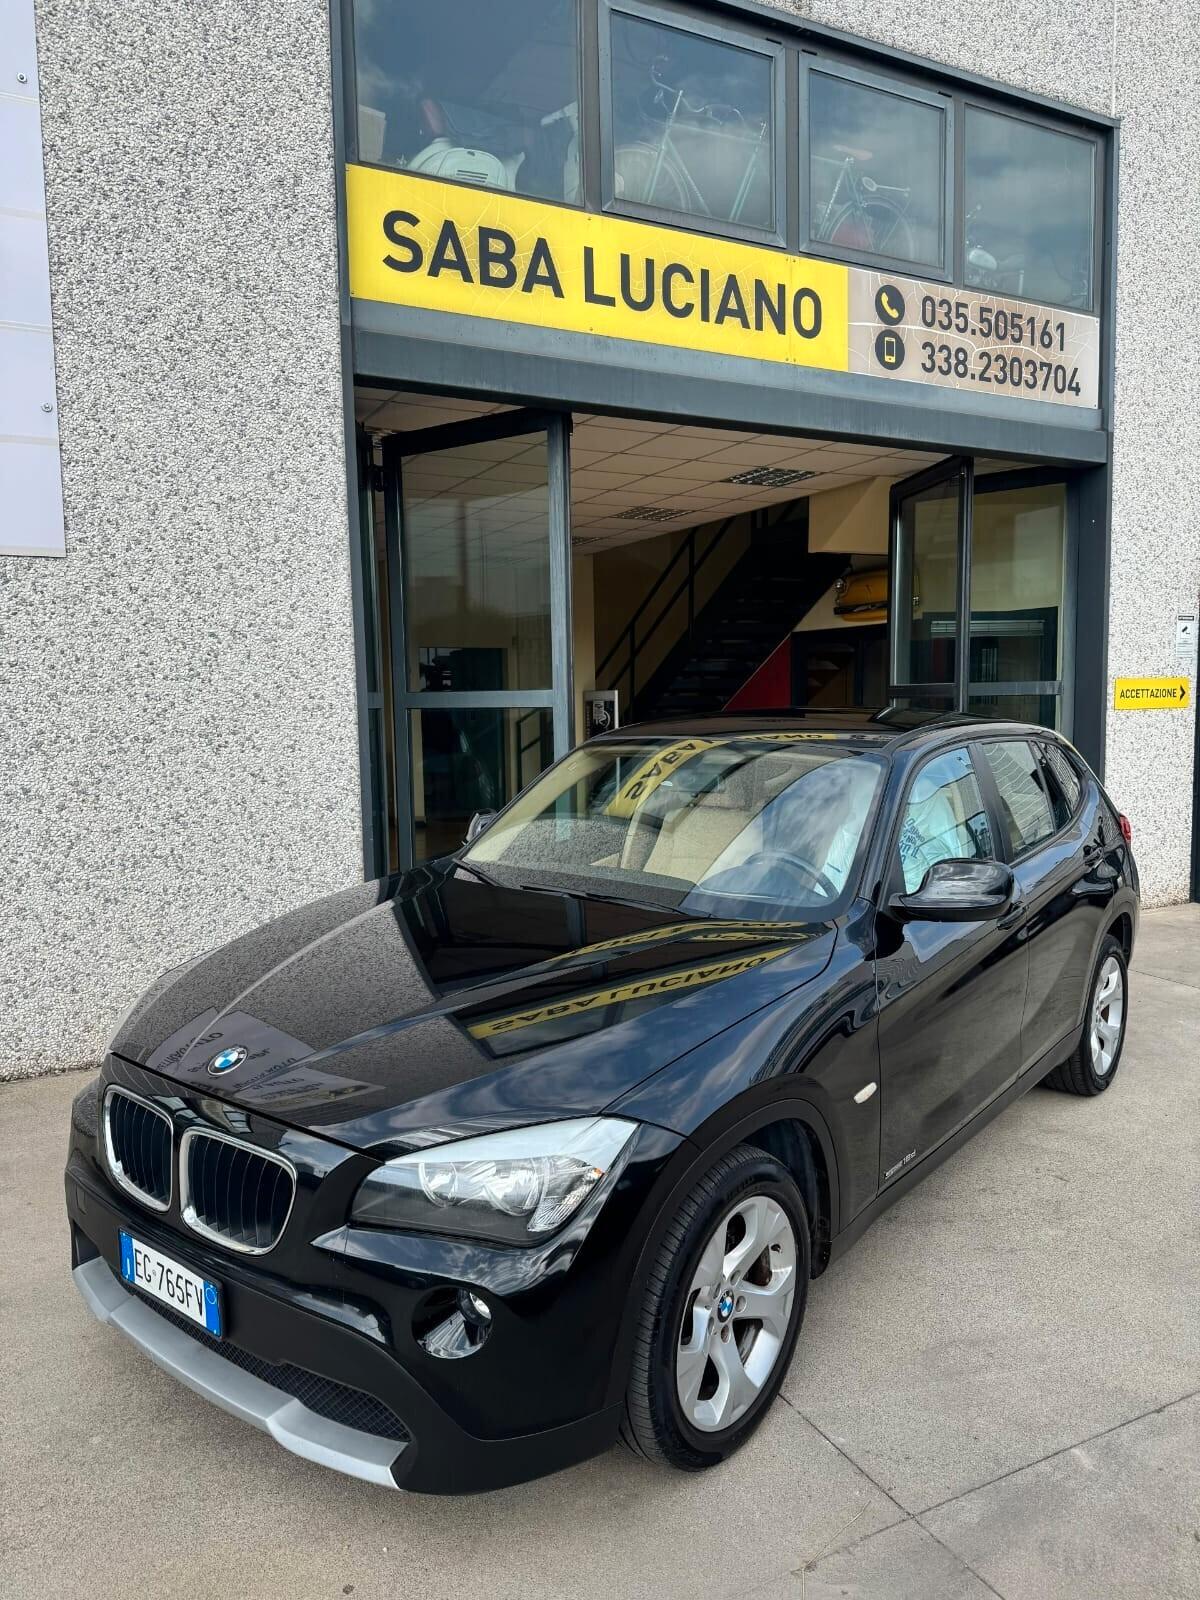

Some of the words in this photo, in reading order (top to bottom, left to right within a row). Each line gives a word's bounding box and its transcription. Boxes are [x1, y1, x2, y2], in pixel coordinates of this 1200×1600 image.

[382, 209, 565, 299] SABA
[583, 246, 823, 340] LUCIANO
[921, 295, 1065, 352] 035.505161
[921, 341, 1081, 397] 338.2303704
[1119, 688, 1178, 699] ACCETTAZIONE
[134, 1247, 152, 1283] EG
[156, 1261, 203, 1317] 765FV
